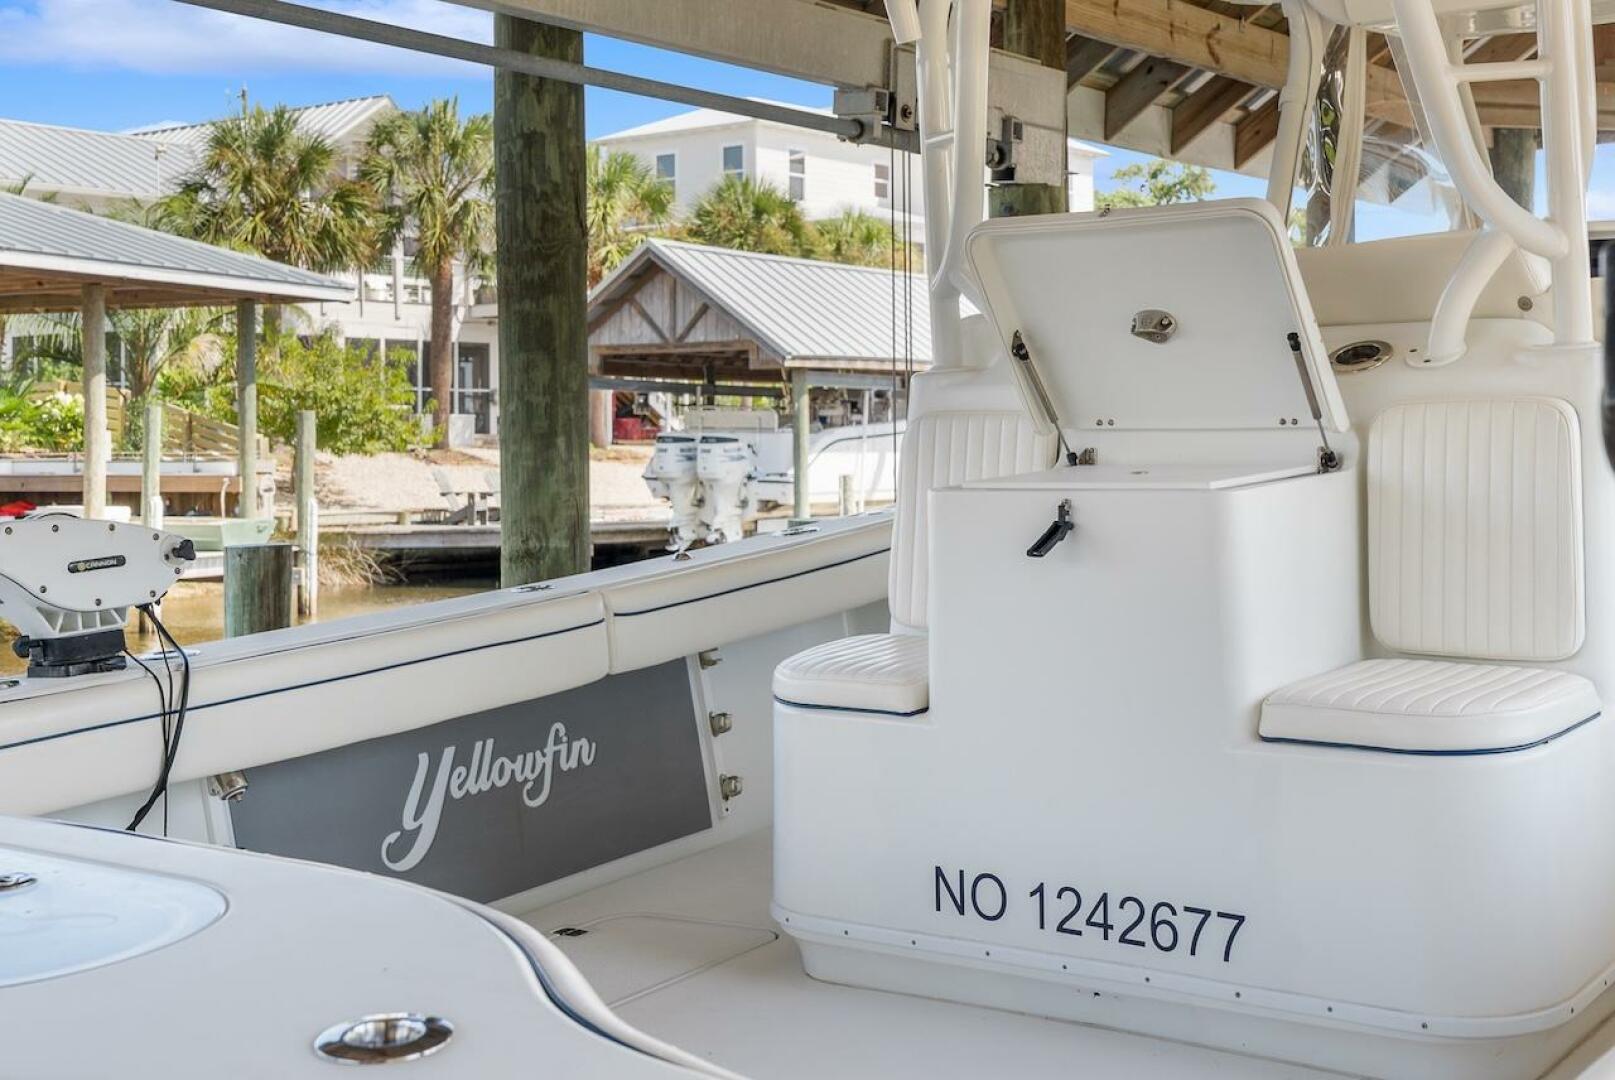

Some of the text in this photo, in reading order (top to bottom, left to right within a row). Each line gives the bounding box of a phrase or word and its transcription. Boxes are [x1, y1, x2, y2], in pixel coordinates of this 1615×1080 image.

[381, 722, 596, 872] Yellowfin
[934, 866, 1246, 962] NO 1242677
